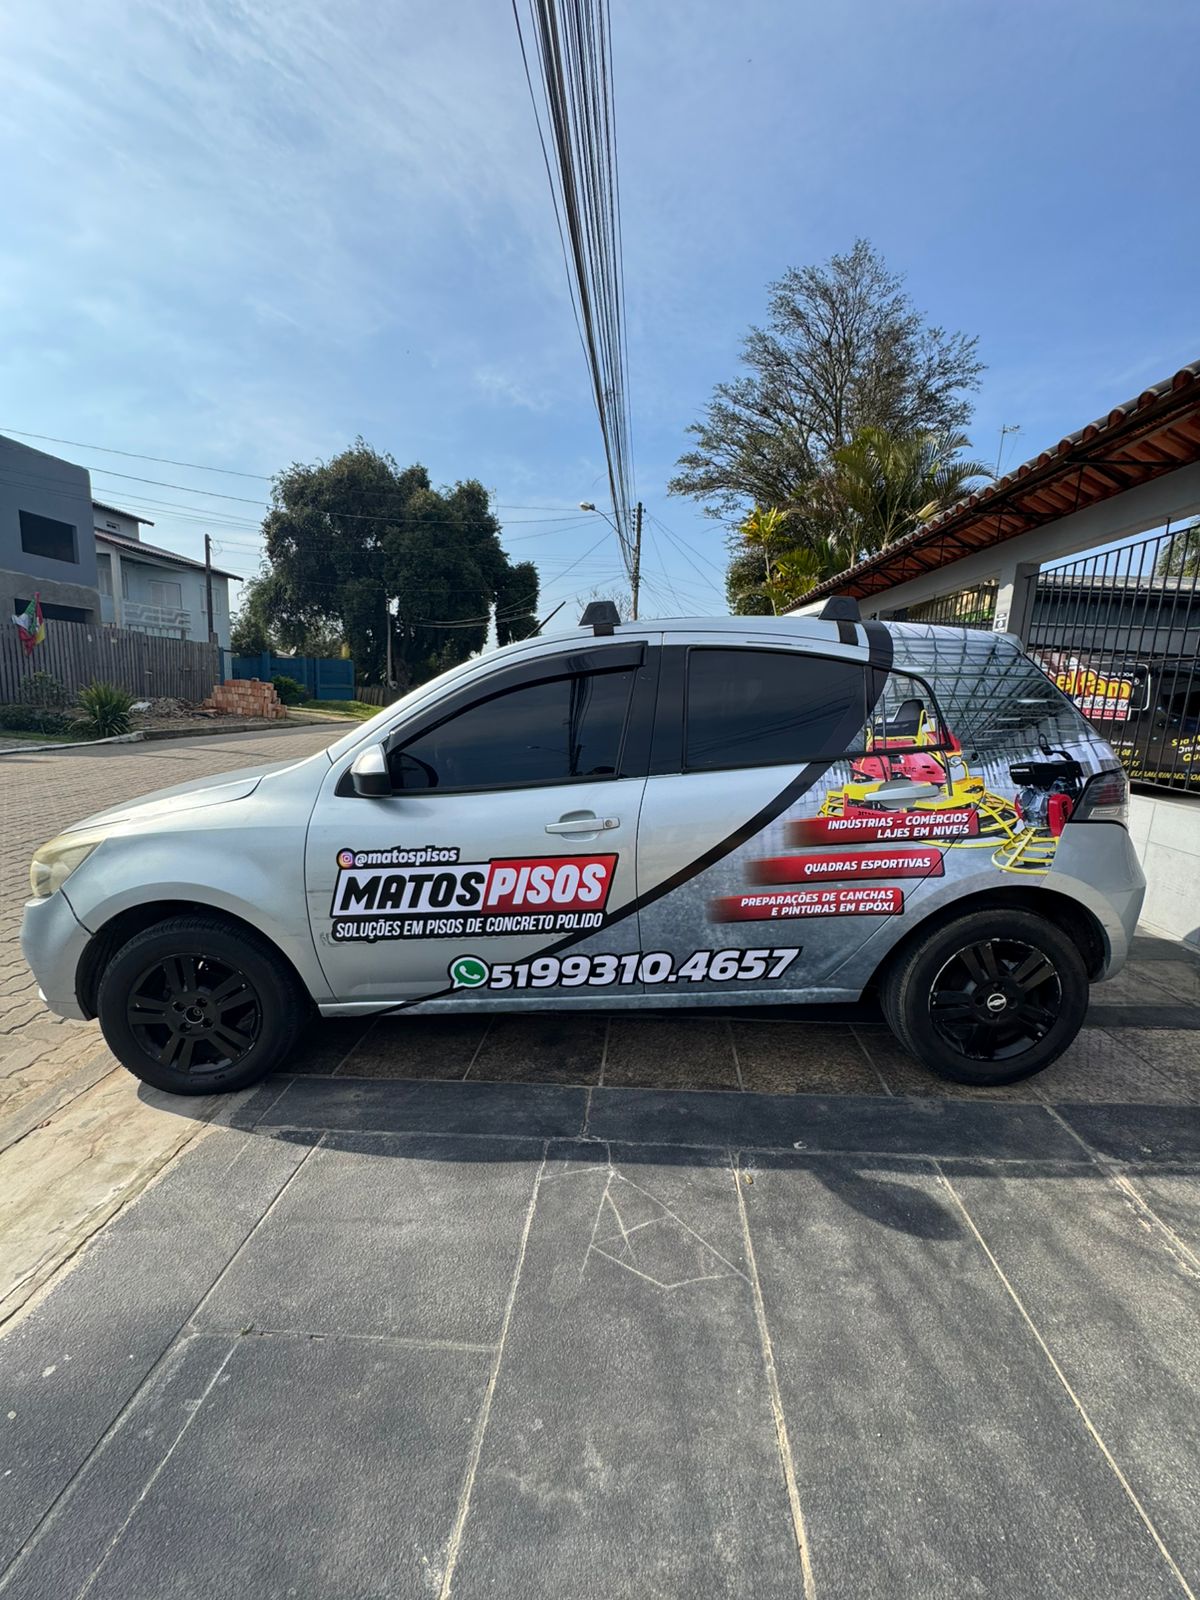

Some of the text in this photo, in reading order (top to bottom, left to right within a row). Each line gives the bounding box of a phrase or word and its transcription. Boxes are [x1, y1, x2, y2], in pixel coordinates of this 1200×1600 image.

[827, 814, 893, 830] INDÚSTRIAS
[905, 812, 969, 827] COMÉRCIOS
[877, 824, 969, 839] LAJES EM NIVEIS
[354, 848, 458, 867] @matospisos
[804, 857, 931, 875] QUADRAS ESPORTIVAS
[741, 889, 894, 907] PREPARAÇÕES DE CANCHAS
[771, 899, 895, 916] E PINTURAS EM EPÓXI
[336, 912, 604, 939] SOLUÇÕES EM PISOS DE CONCRETO POLIDO
